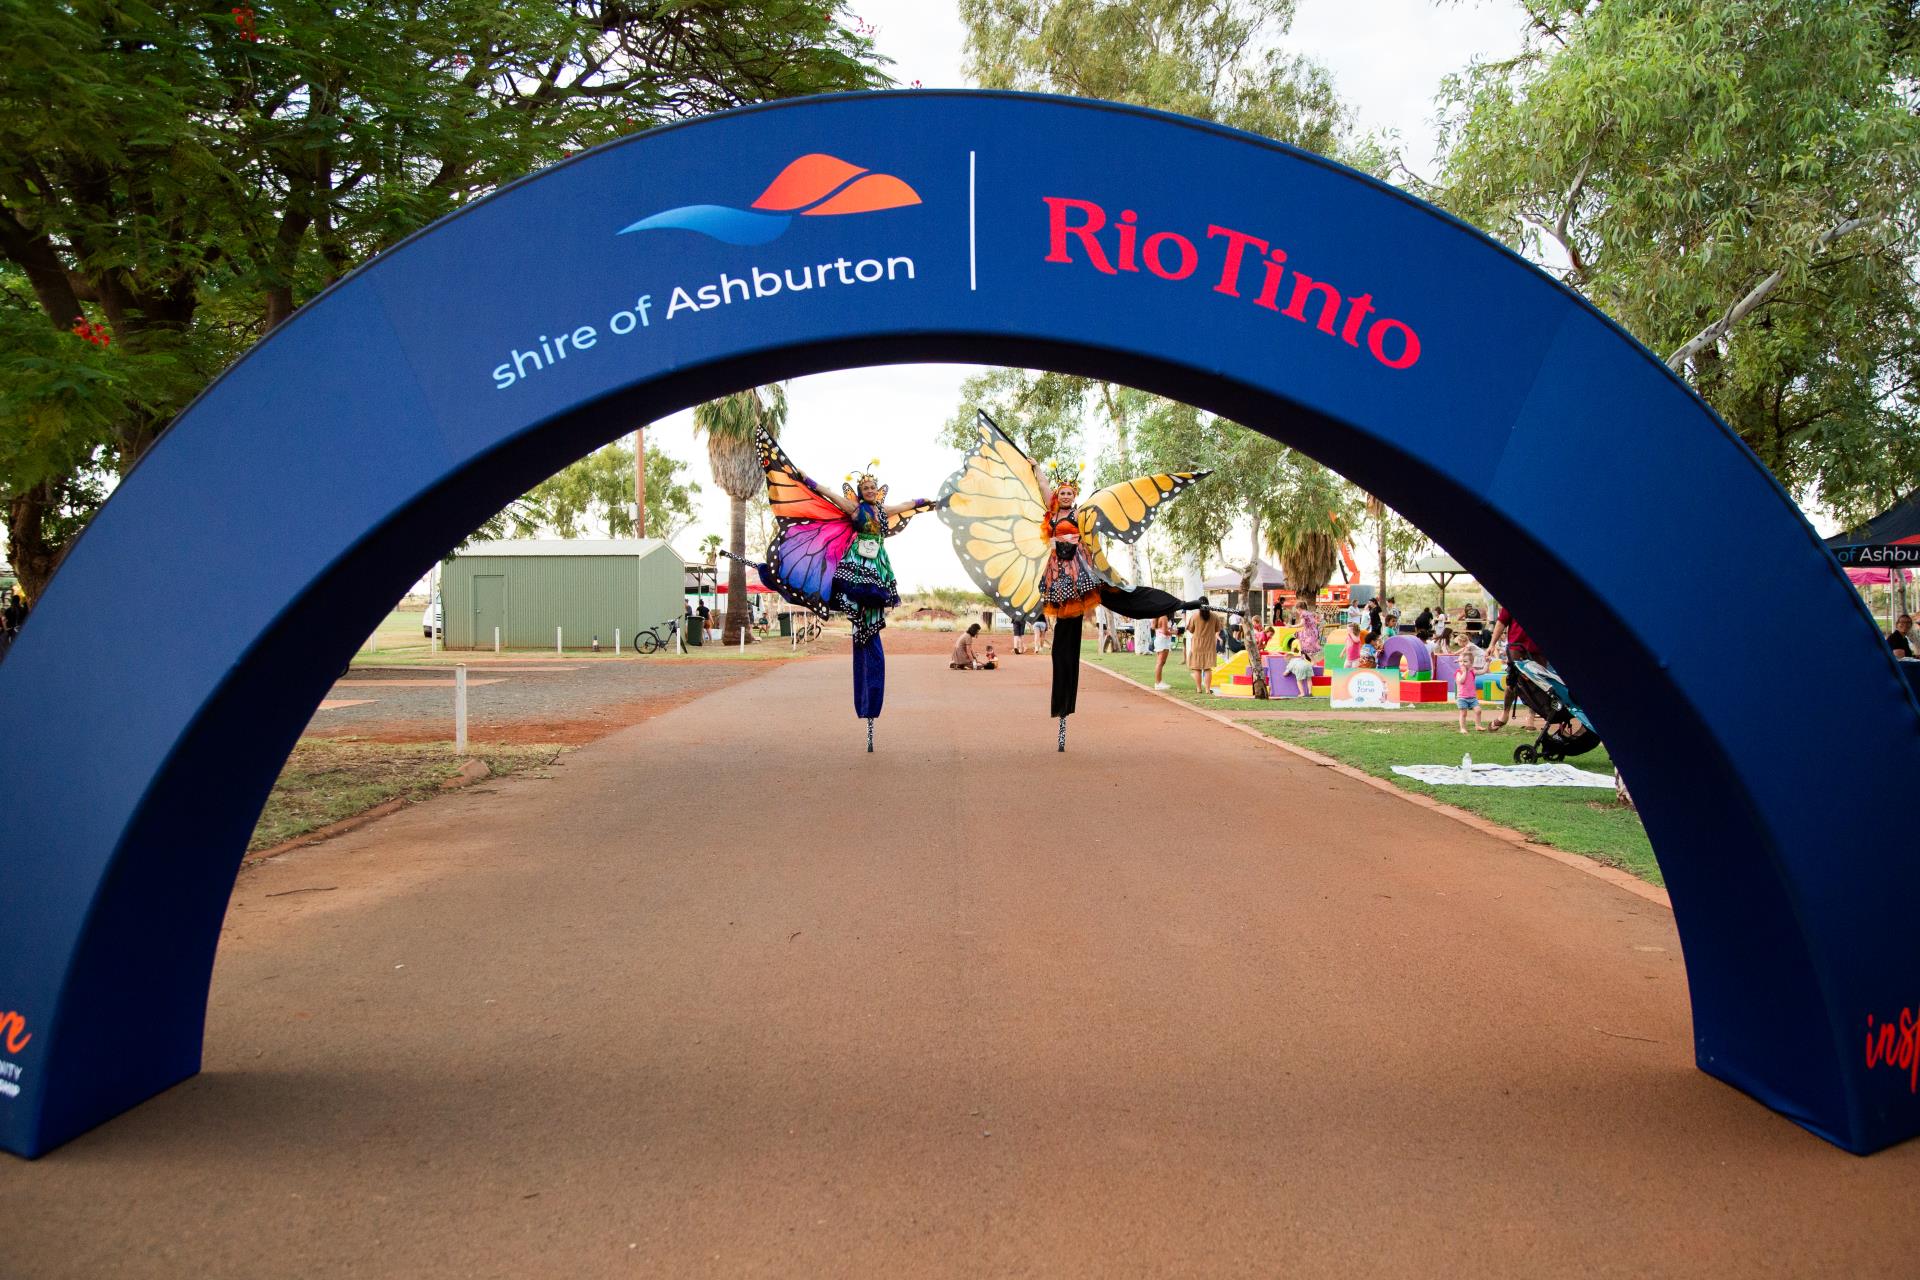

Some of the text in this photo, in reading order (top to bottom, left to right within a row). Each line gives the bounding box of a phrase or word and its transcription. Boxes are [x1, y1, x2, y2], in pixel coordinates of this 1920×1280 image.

[492, 256, 915, 389] shire of Ashburton
[1042, 196, 1421, 369] Rio Tinto
[1838, 546, 1857, 562] of
